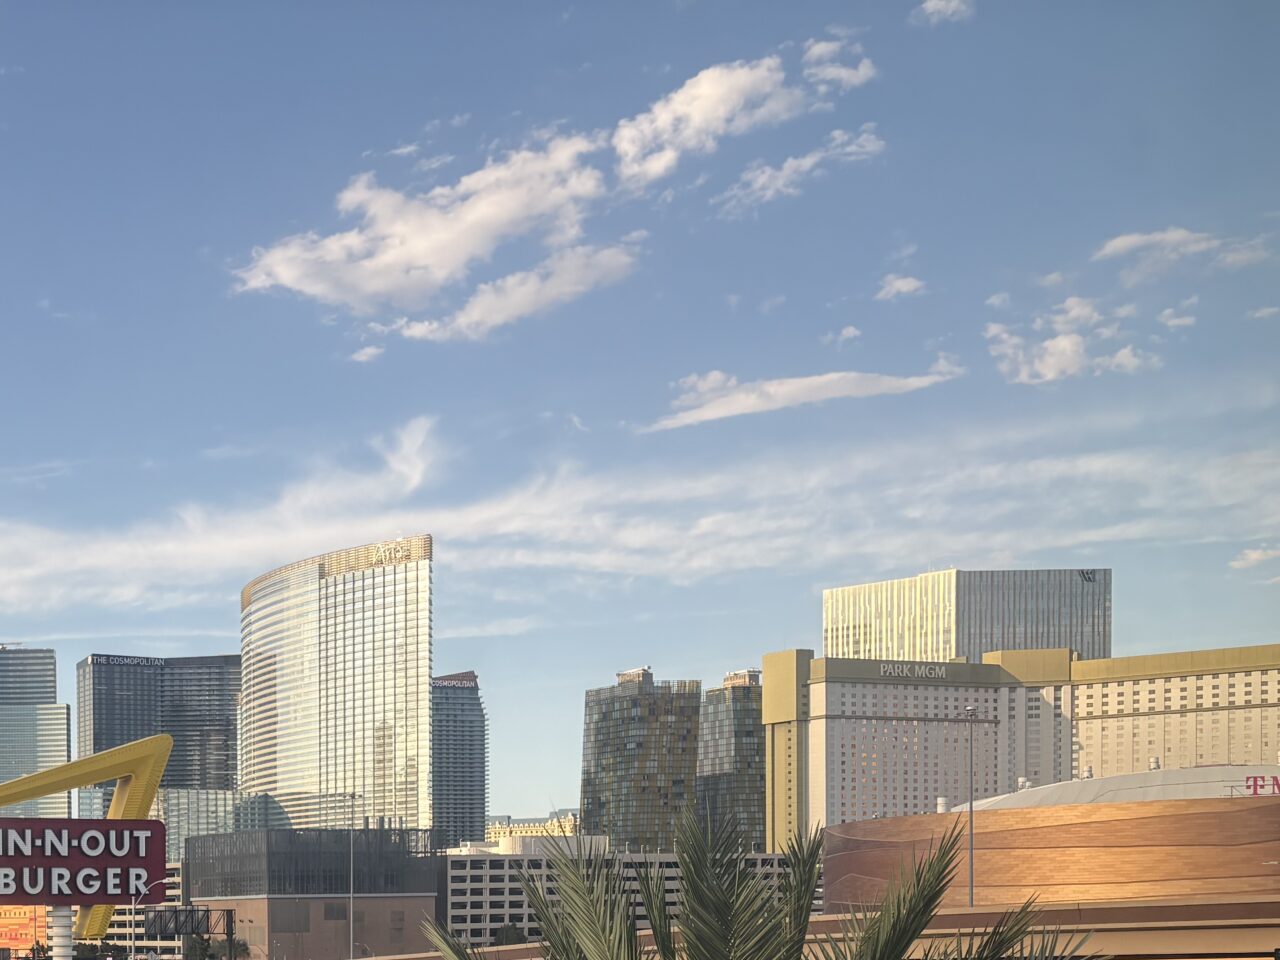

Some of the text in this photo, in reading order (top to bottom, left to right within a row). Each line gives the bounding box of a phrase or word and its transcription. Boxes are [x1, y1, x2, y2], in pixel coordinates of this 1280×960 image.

[92, 656, 165, 666] THE COSMOPOLITAN
[880, 663, 946, 679] PARK MGM
[431, 680, 475, 688] COSMOPOLITAN
